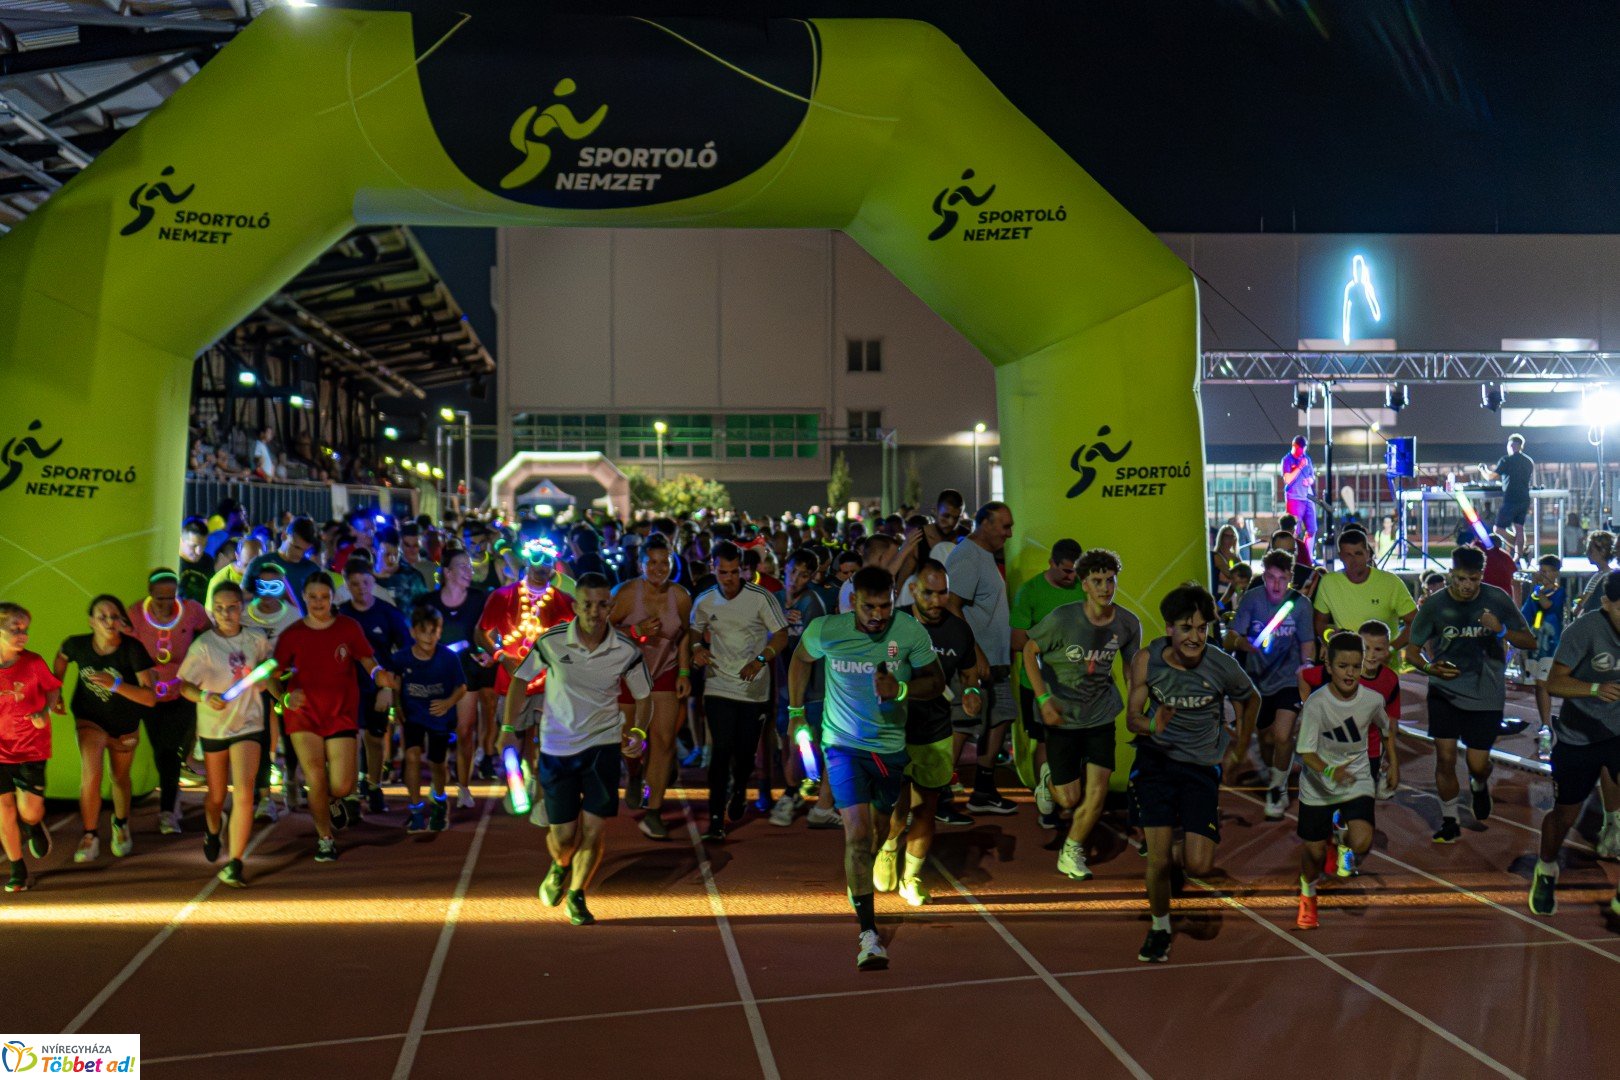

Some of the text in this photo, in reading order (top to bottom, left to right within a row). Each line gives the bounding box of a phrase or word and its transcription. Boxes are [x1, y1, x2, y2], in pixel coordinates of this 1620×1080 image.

[577, 140, 718, 169] SPORTOLÓ
[555, 172, 662, 191] NEMZET
[174, 210, 270, 229] SPORTOLÓ
[977, 204, 1067, 225] SPORTOLÓ
[158, 226, 232, 244] NEMZET
[963, 226, 1033, 242] NEMZET
[41, 464, 136, 483] SPORTOLÓ
[1115, 460, 1191, 480] SPORTOLÓ
[25, 481, 99, 498] NEMZET
[1102, 482, 1167, 498] NEMZET
[831, 658, 902, 674] HUNGRY
[1166, 695, 1214, 708] JAKO
